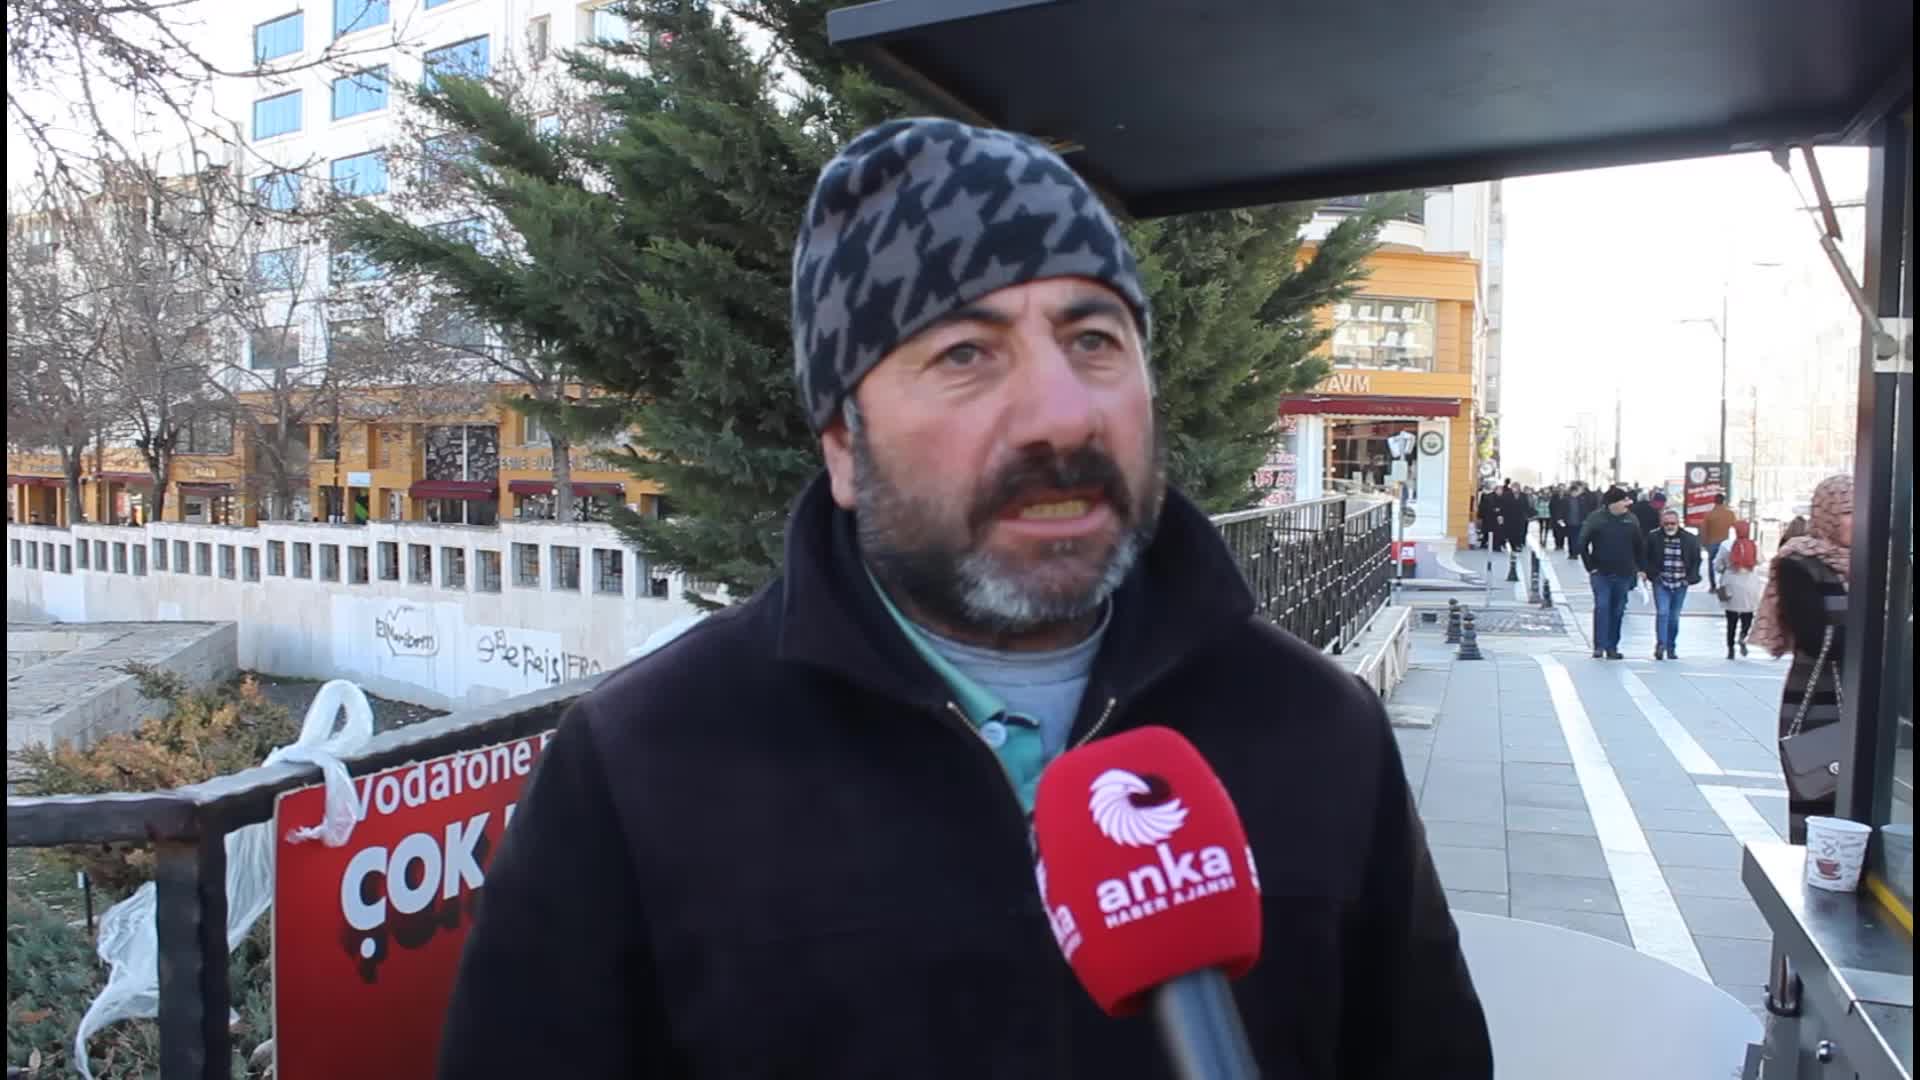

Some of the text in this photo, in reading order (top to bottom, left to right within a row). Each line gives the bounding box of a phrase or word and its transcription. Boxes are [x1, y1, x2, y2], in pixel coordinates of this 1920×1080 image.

[1327, 374, 1371, 393] AVM
[341, 812, 491, 959] ÇOK
[1096, 842, 1233, 913] anka
[1104, 876, 1237, 929] HABER AJANSI
